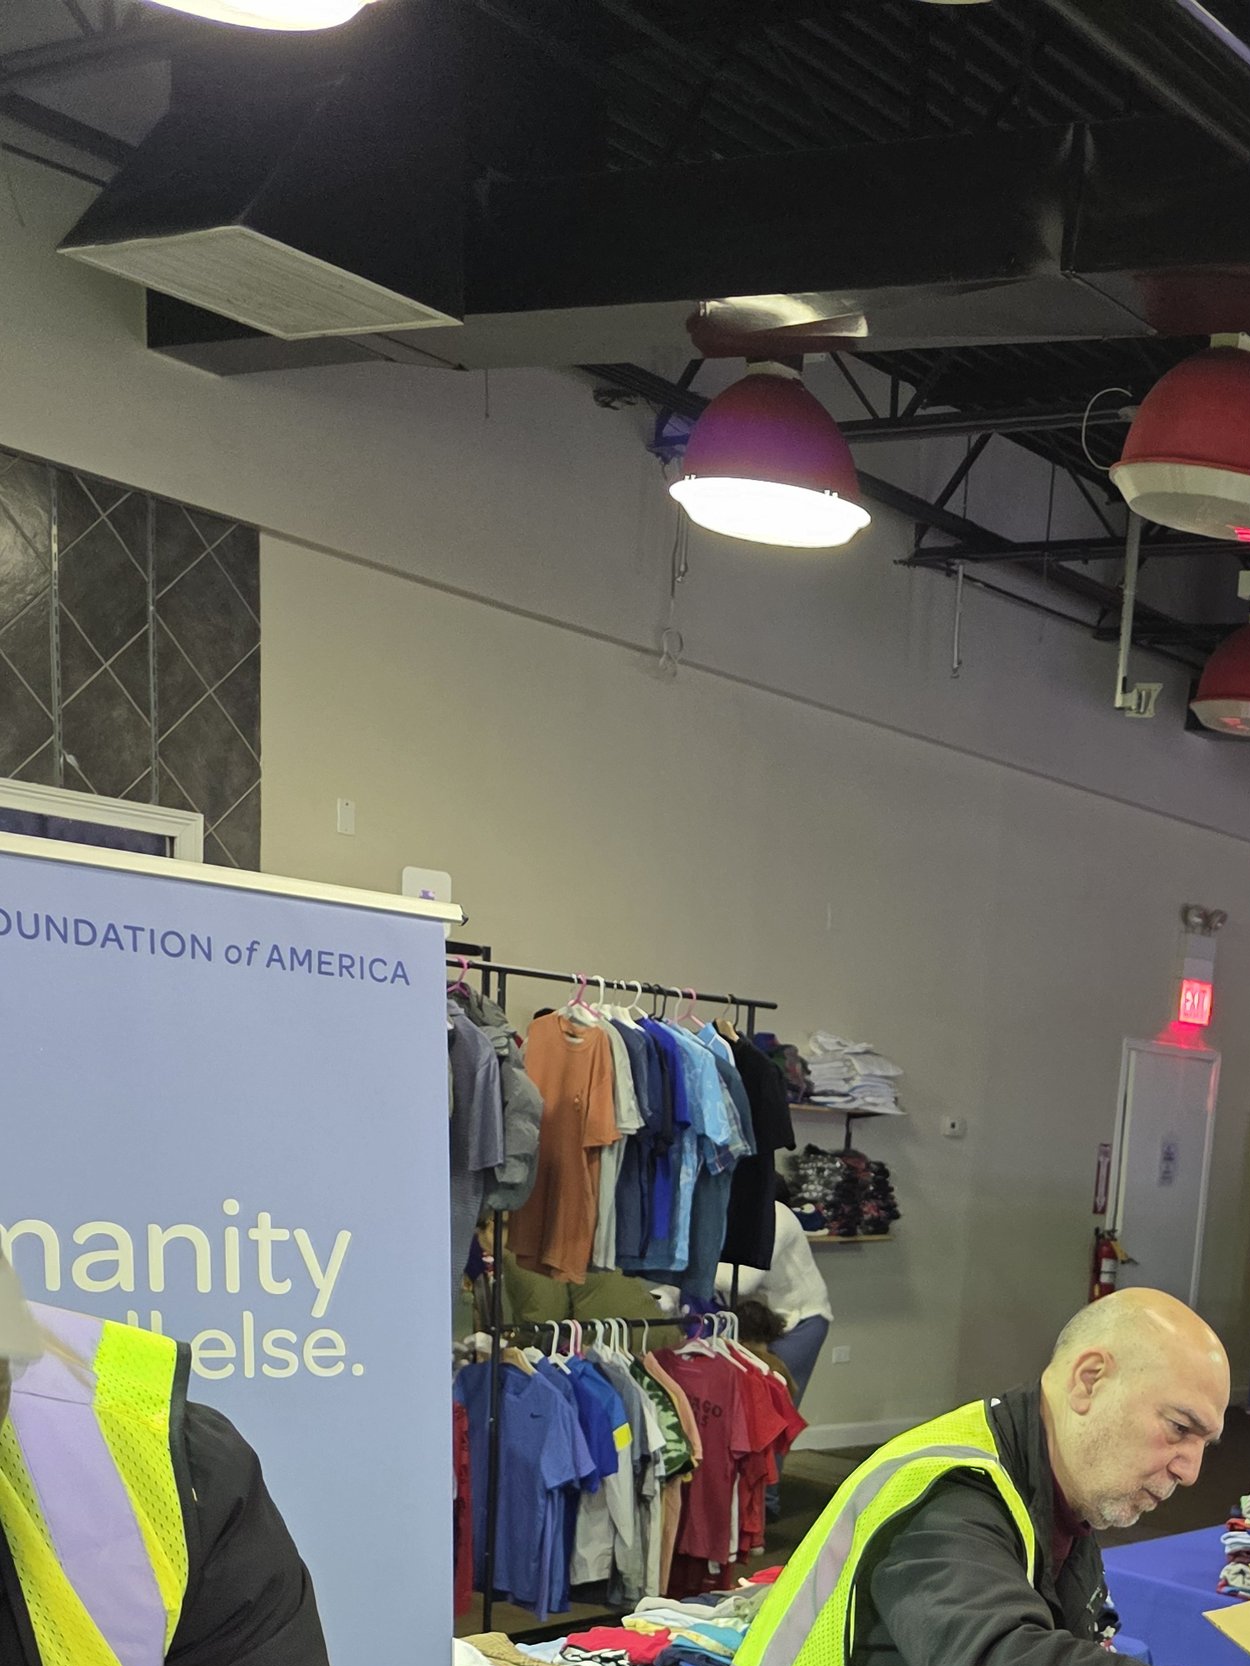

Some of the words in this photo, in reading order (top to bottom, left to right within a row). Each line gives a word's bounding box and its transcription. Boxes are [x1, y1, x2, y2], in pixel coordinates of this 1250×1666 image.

[224, 941, 260, 966] of
[265, 944, 411, 986] AMERICA
[191, 1310, 364, 1379] else.
